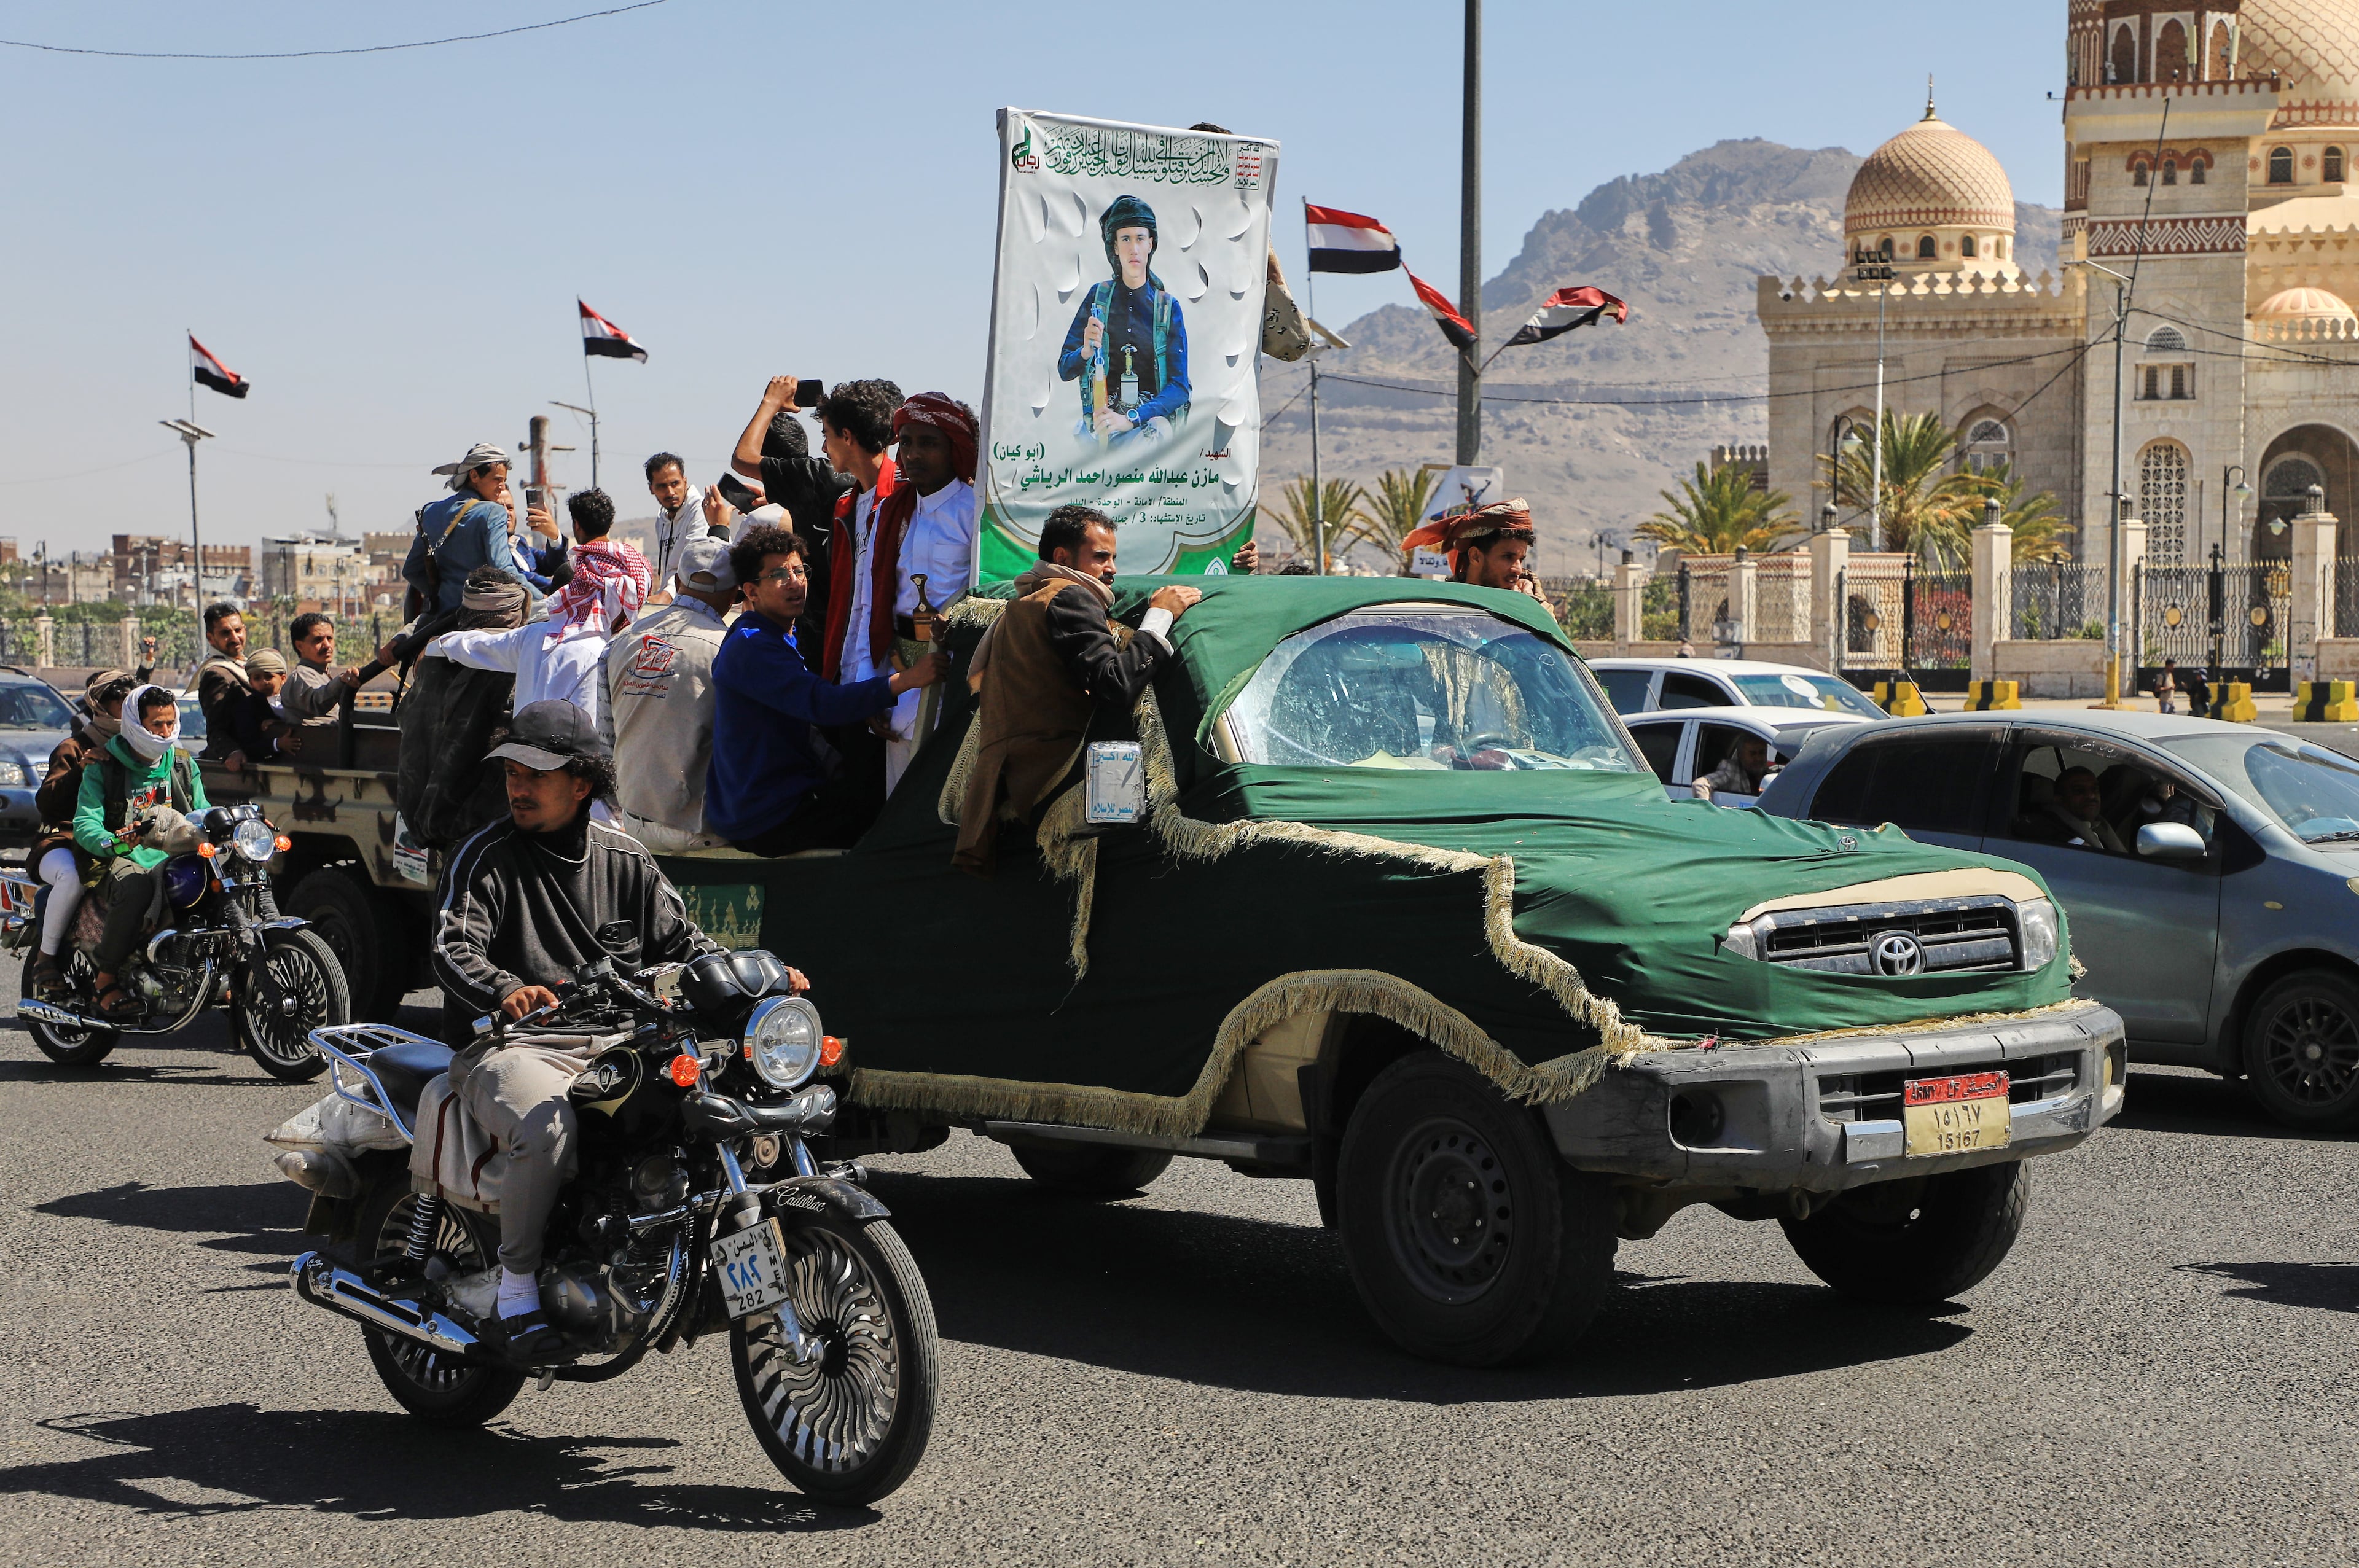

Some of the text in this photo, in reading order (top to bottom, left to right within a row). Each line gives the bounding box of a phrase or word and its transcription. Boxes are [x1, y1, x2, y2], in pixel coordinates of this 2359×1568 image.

[1017, 154, 1039, 169] رجال
[993, 441, 1021, 461] كيان)
[1205, 448, 1232, 461] الشهيد
[1020, 465, 1072, 491] الرياشي
[1149, 464, 1187, 488] عبدالله
[1192, 468, 1219, 488] مازن
[1097, 498, 1123, 508] الوحدة
[1140, 512, 1146, 522] 3
[1186, 514, 1205, 525] تاريخ
[1093, 802, 1115, 816] للإسلام
[1934, 1102, 1981, 1129] ١٥١٦٧
[1937, 1128, 1981, 1150] 15167
[777, 1185, 826, 1212] Cadillac
[734, 1232, 757, 1258] اليمن
[727, 1254, 762, 1292] ٢٨٢
[737, 1290, 764, 1311] 282
